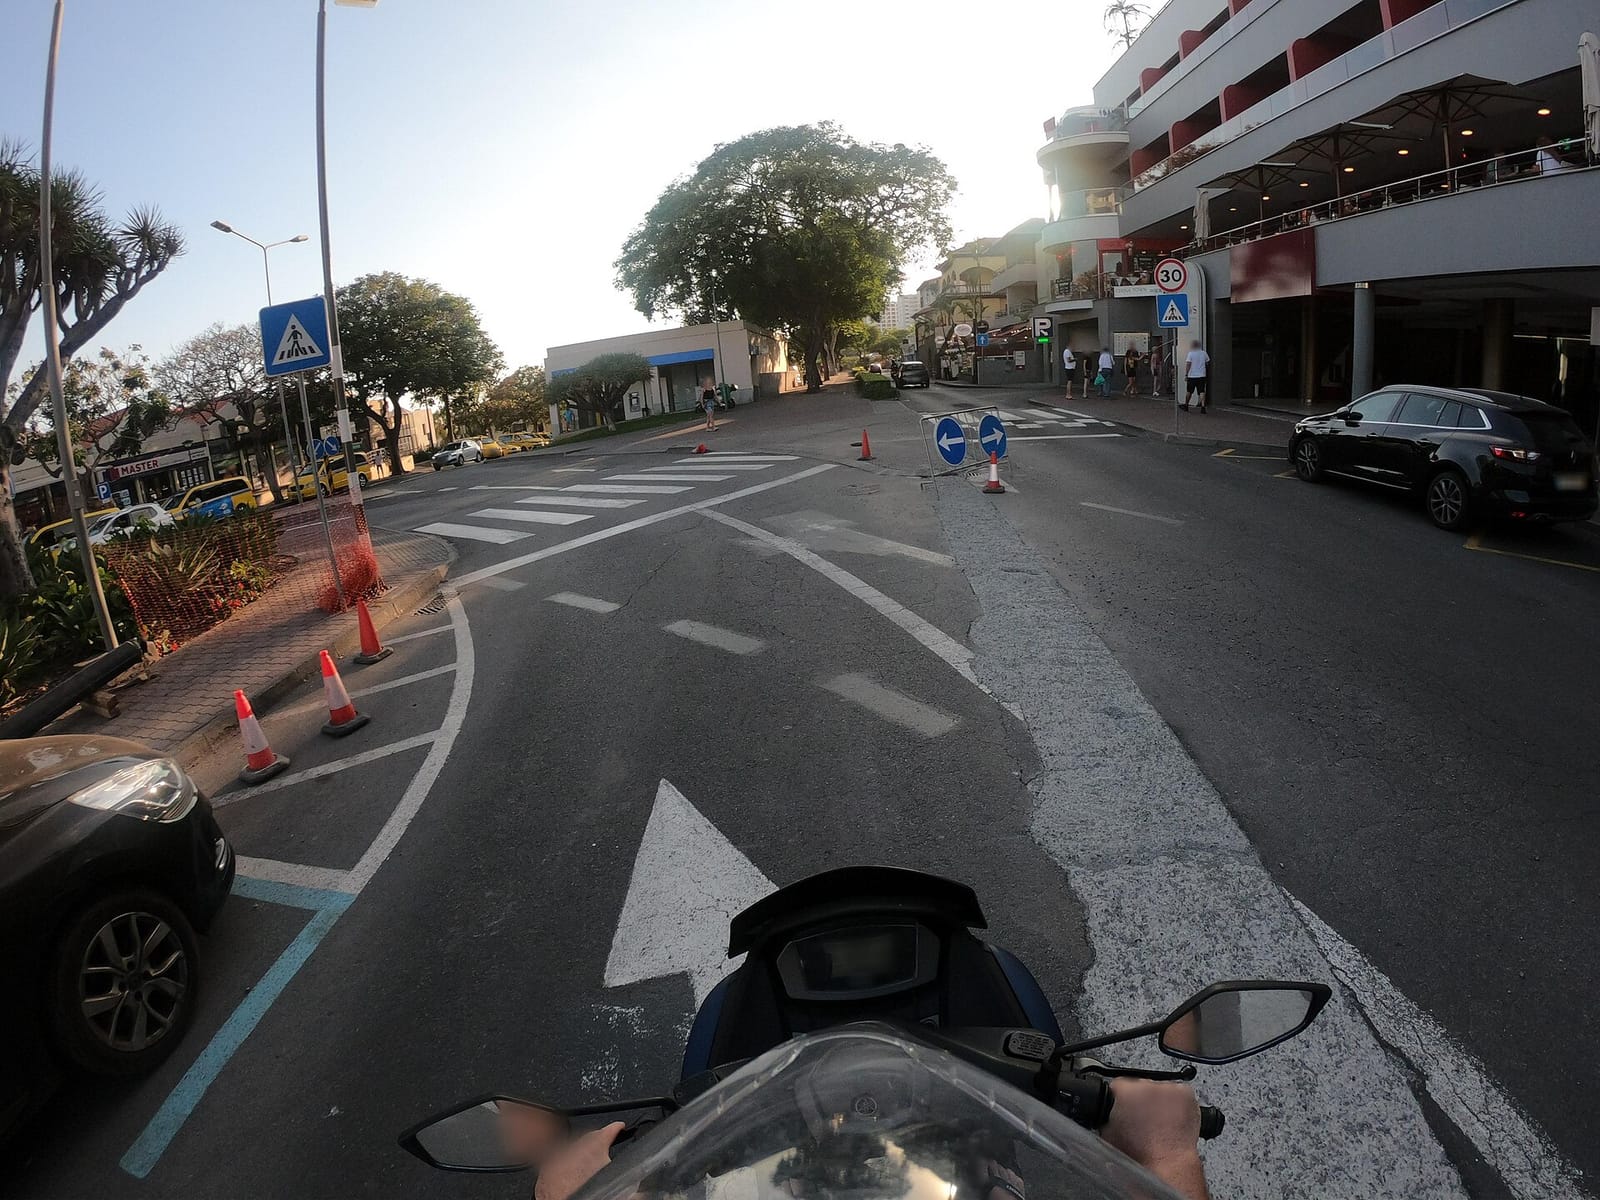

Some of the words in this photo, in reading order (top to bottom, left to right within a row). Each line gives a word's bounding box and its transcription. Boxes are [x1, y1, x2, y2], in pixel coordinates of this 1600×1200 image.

[1160, 269, 1182, 283] 30
[121, 460, 159, 476] MASTER
[99, 485, 107, 499] P
